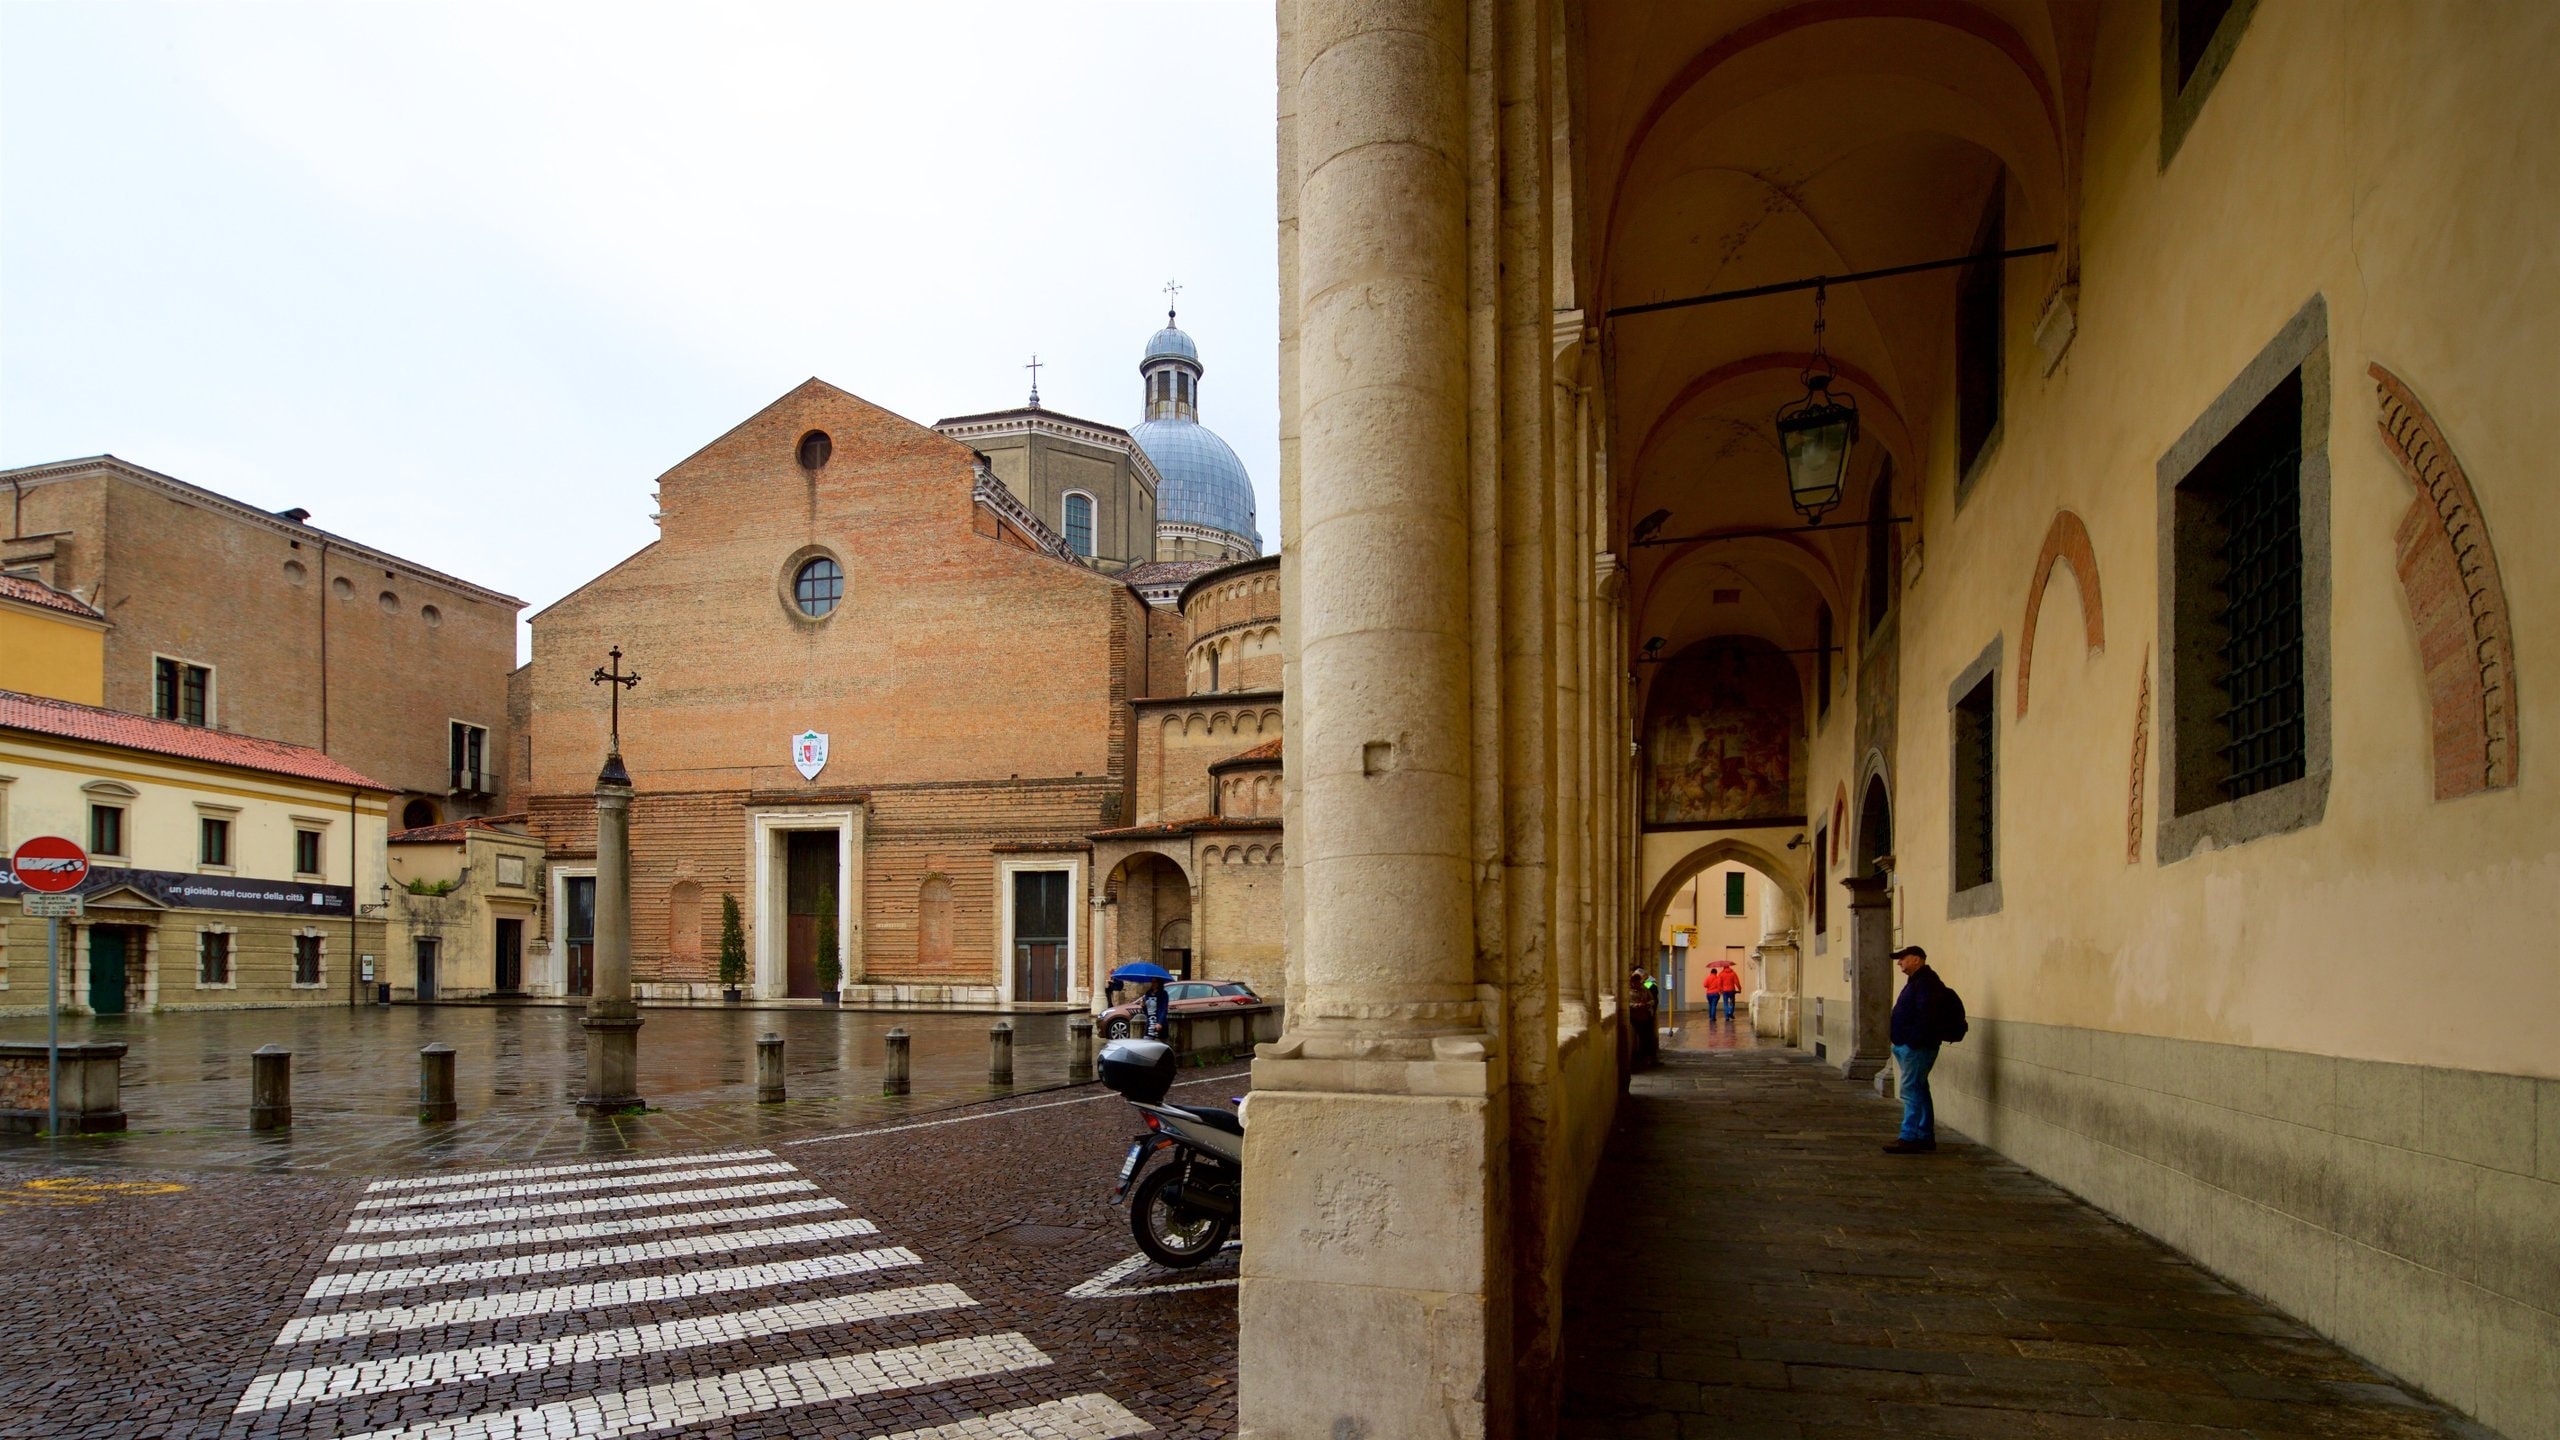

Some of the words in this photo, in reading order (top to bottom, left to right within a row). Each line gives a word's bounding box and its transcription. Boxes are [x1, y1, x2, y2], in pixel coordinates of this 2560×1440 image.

[184, 886, 219, 896] gioiello
[220, 889, 235, 897] nel
[236, 890, 262, 899] cuore
[263, 891, 284, 901] della
[285, 893, 305, 902] città
